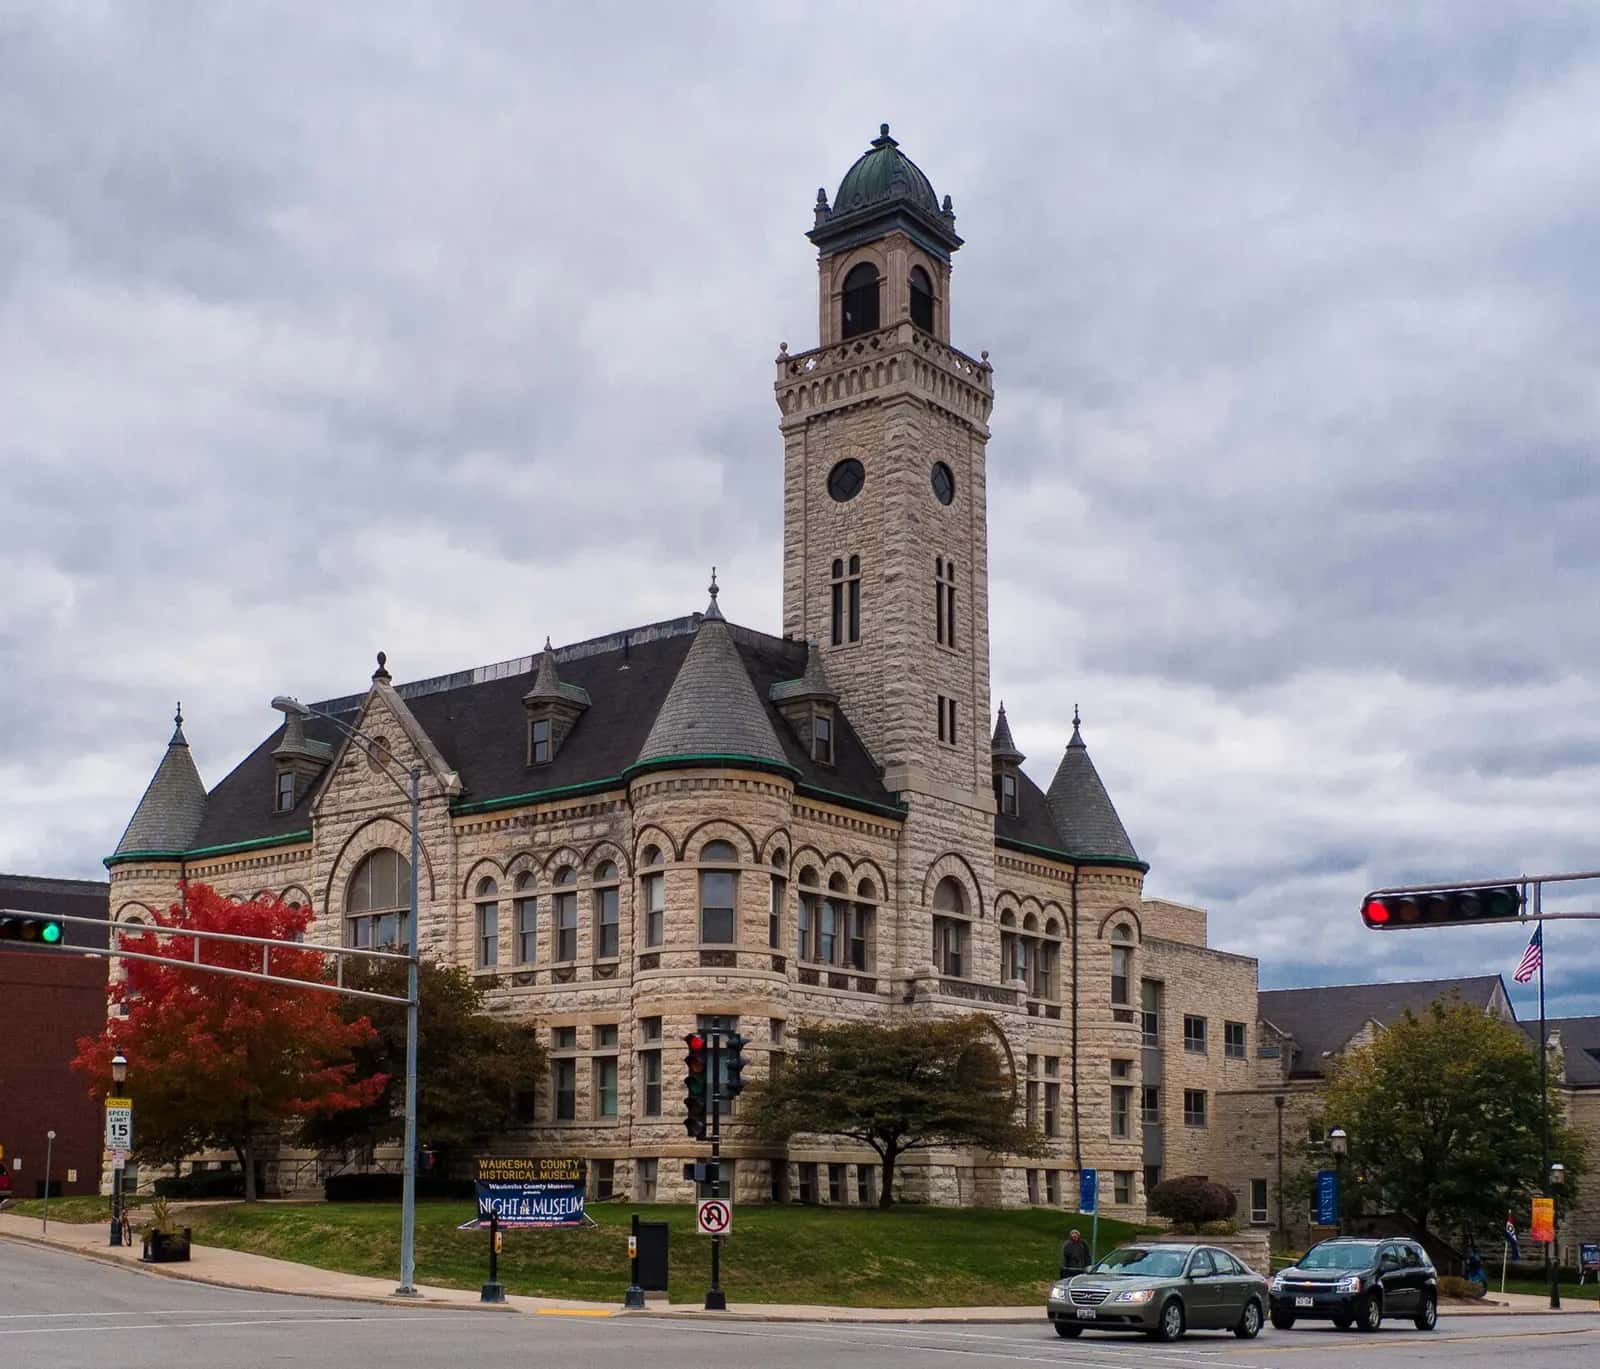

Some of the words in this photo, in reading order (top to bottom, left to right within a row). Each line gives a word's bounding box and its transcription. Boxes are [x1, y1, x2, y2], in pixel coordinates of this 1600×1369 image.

[111, 1123, 128, 1137] 15
[479, 1159, 534, 1169] WAUKESHA
[540, 1159, 580, 1169] COUNTY
[479, 1170, 538, 1180] HISTORICAL
[540, 1170, 580, 1180] MUSEUM
[1321, 1177, 1333, 1220] MUSEUM
[478, 1197, 519, 1216] NIGHT
[532, 1196, 585, 1216] MUSEUM
